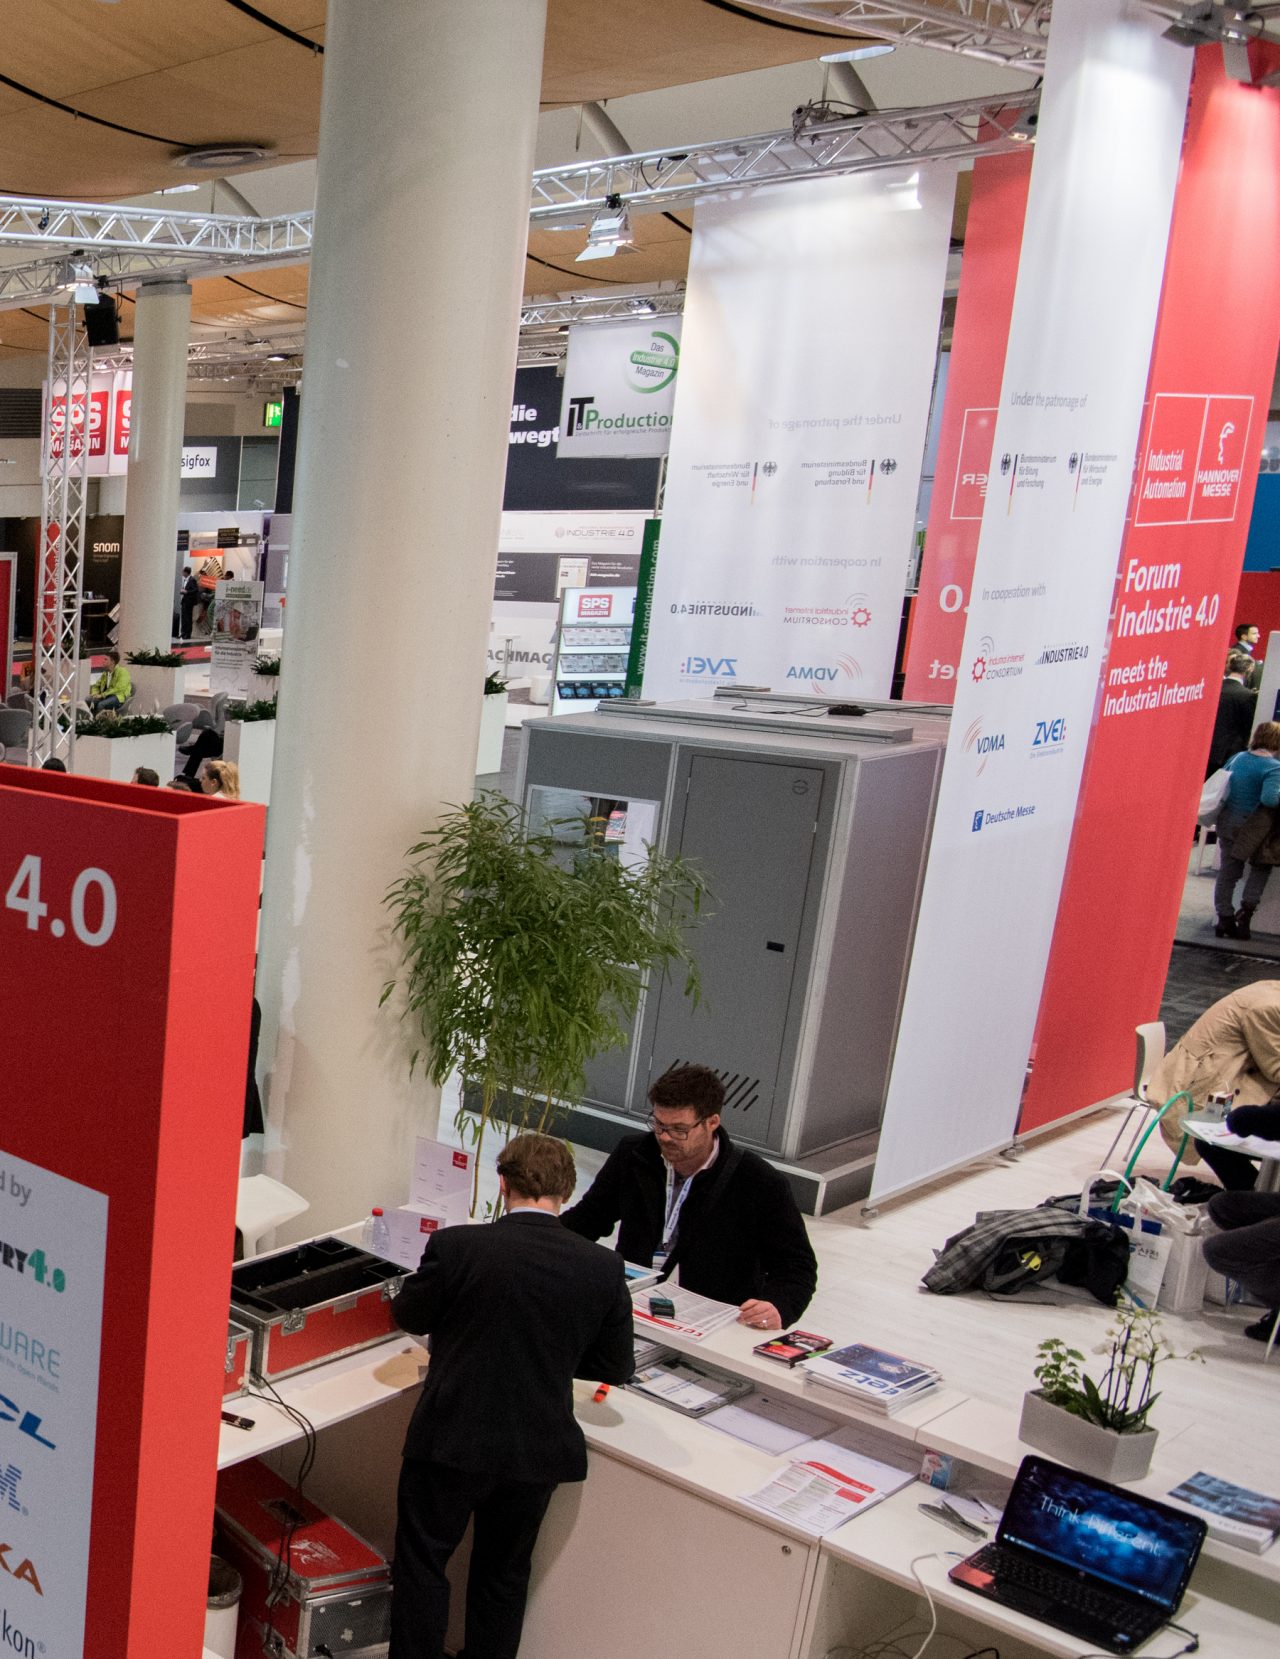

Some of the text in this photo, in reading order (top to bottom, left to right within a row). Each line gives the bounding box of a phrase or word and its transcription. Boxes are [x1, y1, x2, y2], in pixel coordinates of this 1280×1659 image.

[651, 342, 664, 352] Das
[632, 352, 662, 365] Industrie
[635, 366, 664, 379] Magazin
[1010, 391, 1088, 411] Under the patronage of
[51, 401, 102, 432] SPS
[181, 454, 210, 470] sigfox
[1148, 450, 1184, 472] Industrial
[1197, 469, 1239, 484] HANNOVER
[1143, 477, 1186, 500] Automation
[1202, 483, 1232, 497] MESSE
[566, 529, 616, 537] INDUSTRIE
[93, 541, 120, 553] snom
[1125, 559, 1180, 593] Forum
[982, 582, 1047, 601] In cooperation with
[580, 609, 609, 617] MAGAZIN
[581, 597, 609, 609] SPS
[637, 539, 660, 676] www.it-production.com
[1117, 593, 1219, 638] Industrie 4.0
[986, 666, 1023, 681] CONSORTIUM
[1109, 654, 1168, 686] meets the
[1103, 678, 1205, 717] Industrial Internet
[977, 733, 1005, 754] VDMA
[985, 804, 1036, 825] Deutsche Messe
[5, 853, 117, 948] 4.0
[11, 1174, 32, 1207] by
[837, 1369, 887, 1391] etz
[1039, 1495, 1082, 1524] Think
